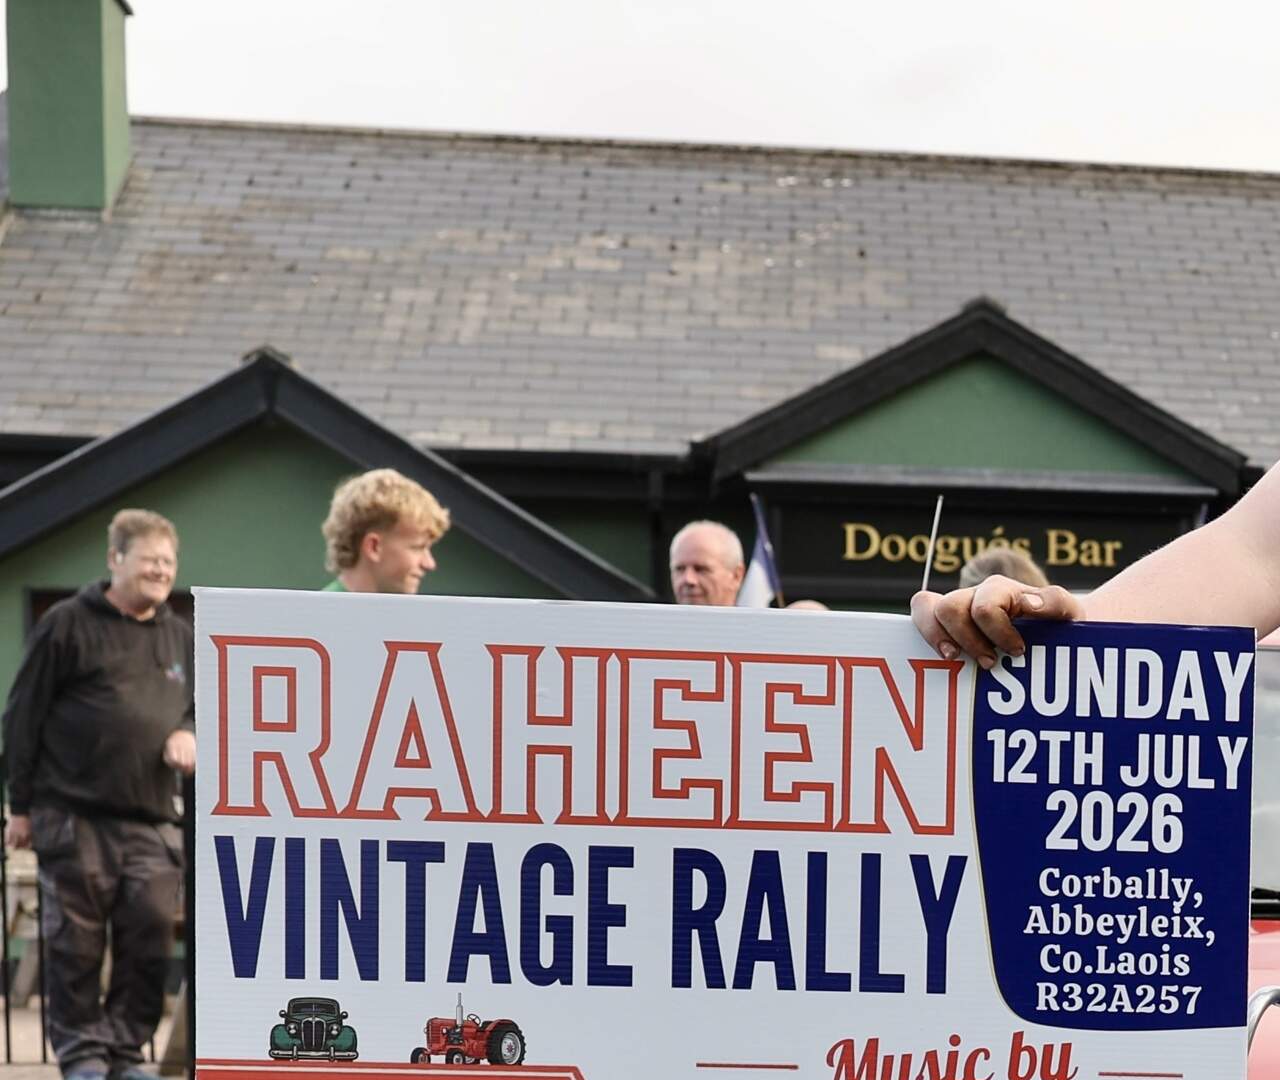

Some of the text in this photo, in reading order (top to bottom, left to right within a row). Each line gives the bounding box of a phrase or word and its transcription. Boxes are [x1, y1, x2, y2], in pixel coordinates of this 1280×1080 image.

[1047, 529, 1123, 567] Bar
[988, 645, 1254, 722] SUNDAY
[211, 635, 965, 835] RAHEEN
[988, 728, 1248, 791] 12TH JULY
[1046, 789, 1184, 852] 2026
[1038, 867, 1204, 909] Corbally,
[214, 836, 970, 995] VINTAGE RALLY
[1024, 906, 1215, 948] Abbeyleix,
[1039, 943, 1190, 977] Co.Laois
[1036, 982, 1202, 1015] R32A257
